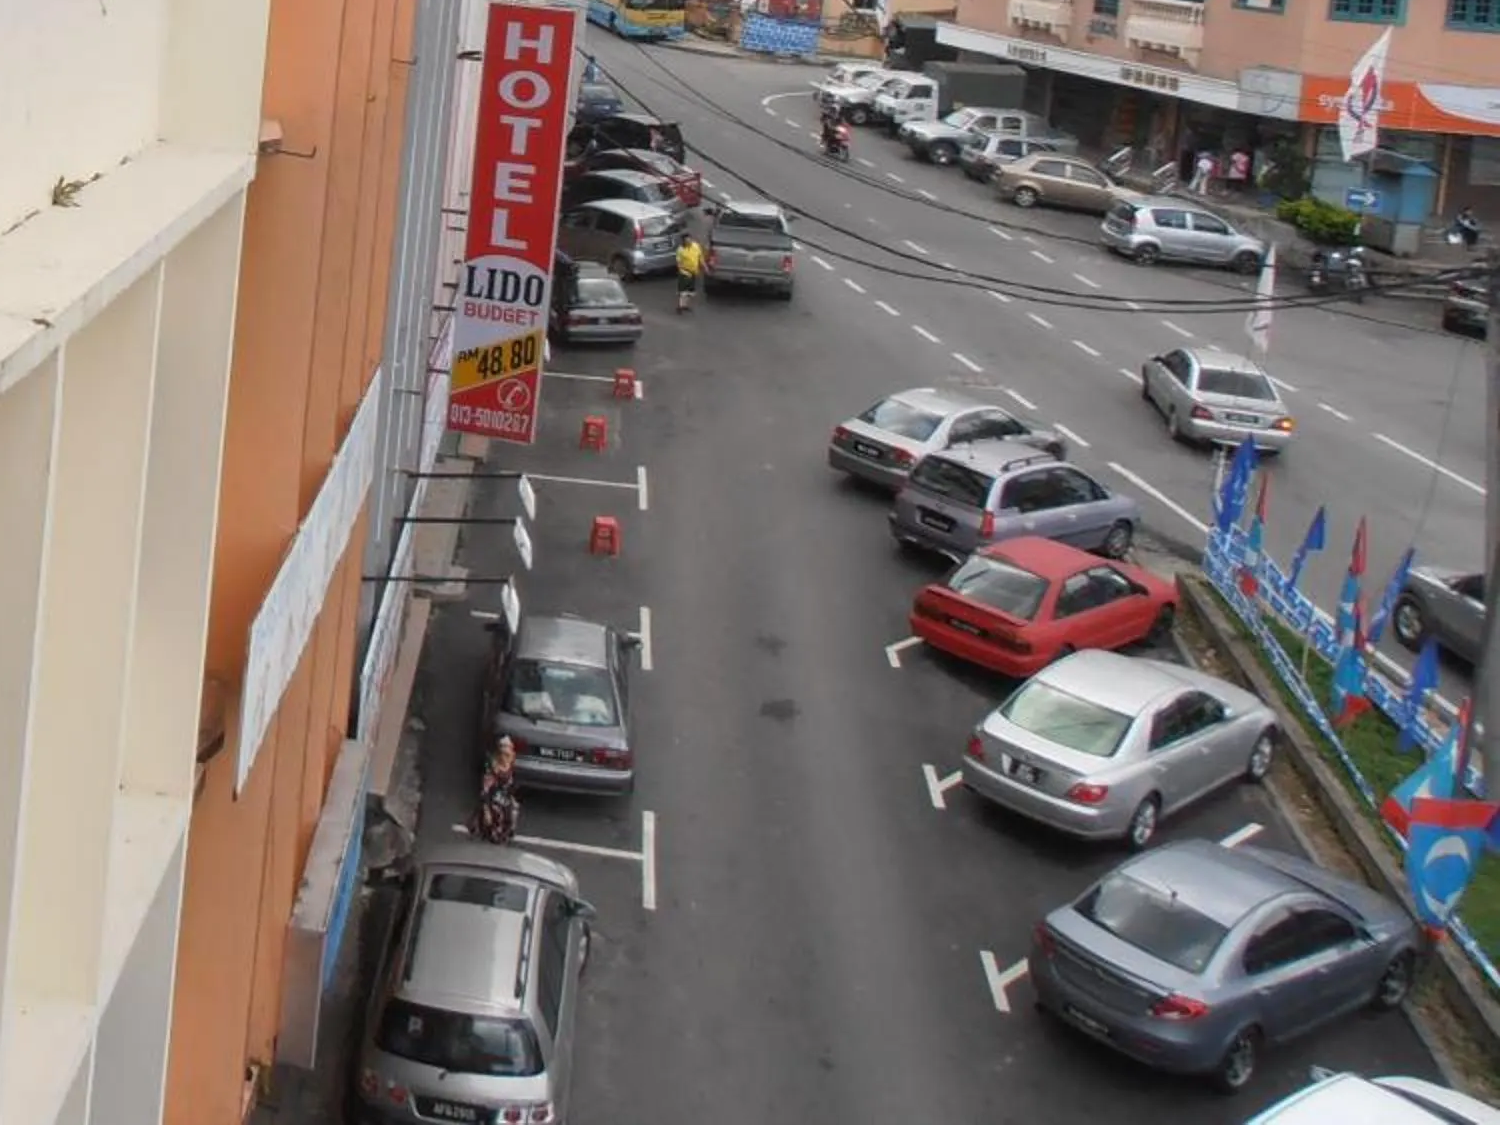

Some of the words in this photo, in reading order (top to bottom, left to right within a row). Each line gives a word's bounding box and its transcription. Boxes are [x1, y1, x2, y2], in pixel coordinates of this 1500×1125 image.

[490, 21, 554, 250] HOTEL
[464, 264, 544, 307] LIDO
[463, 301, 540, 325] BUDGET
